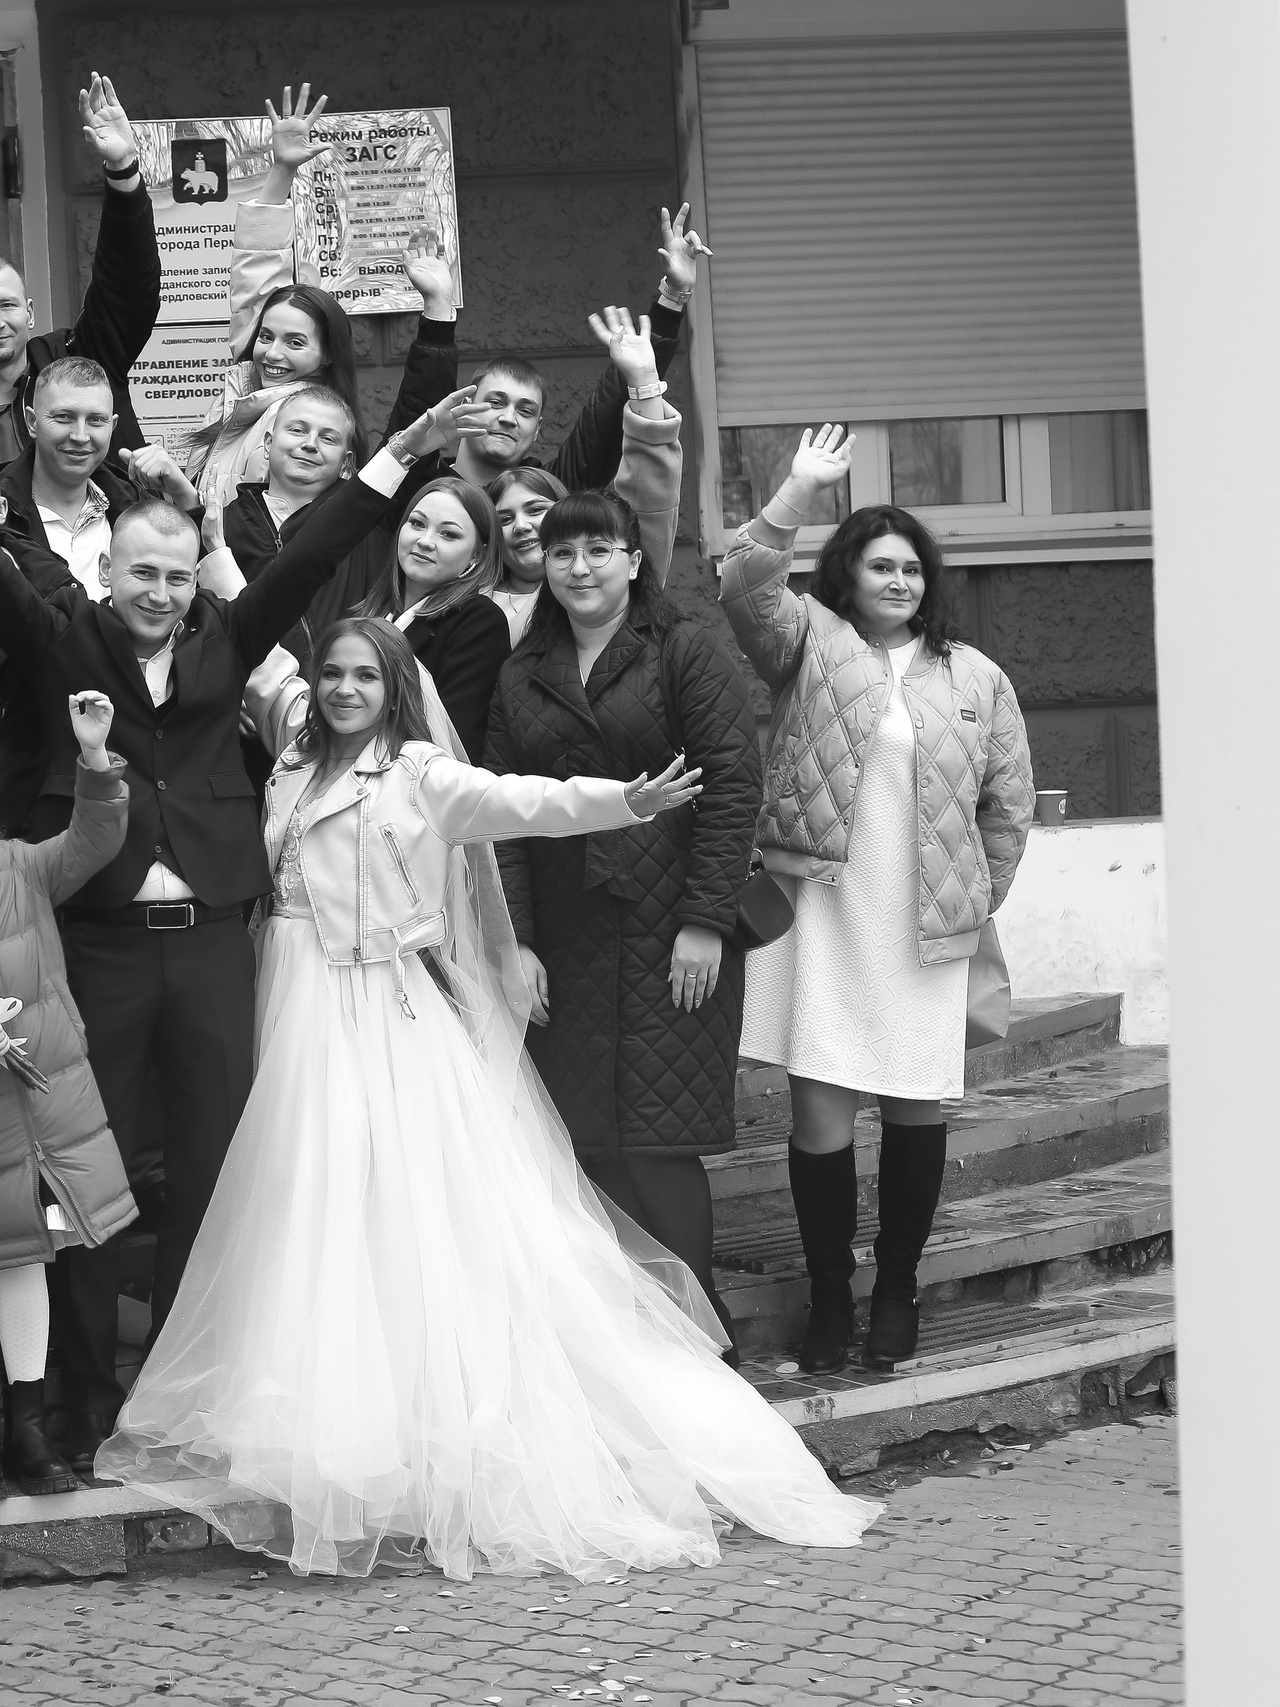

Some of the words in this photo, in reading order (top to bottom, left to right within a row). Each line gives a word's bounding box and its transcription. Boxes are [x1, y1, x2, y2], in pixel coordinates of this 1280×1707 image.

[309, 130, 362, 143] Режим
[369, 125, 430, 142] работы
[345, 144, 397, 162] ЗАГС
[155, 224, 236, 236] дминистрац
[204, 238, 234, 250] Перм
[160, 268, 199, 276] вление
[201, 266, 231, 275] запис
[359, 265, 405, 275] выход
[160, 280, 211, 290] данского
[159, 290, 227, 303] ердловский
[133, 359, 208, 370] ПРАВЛЕНИЕ
[145, 388, 224, 399] СВЕРДЛОВС
